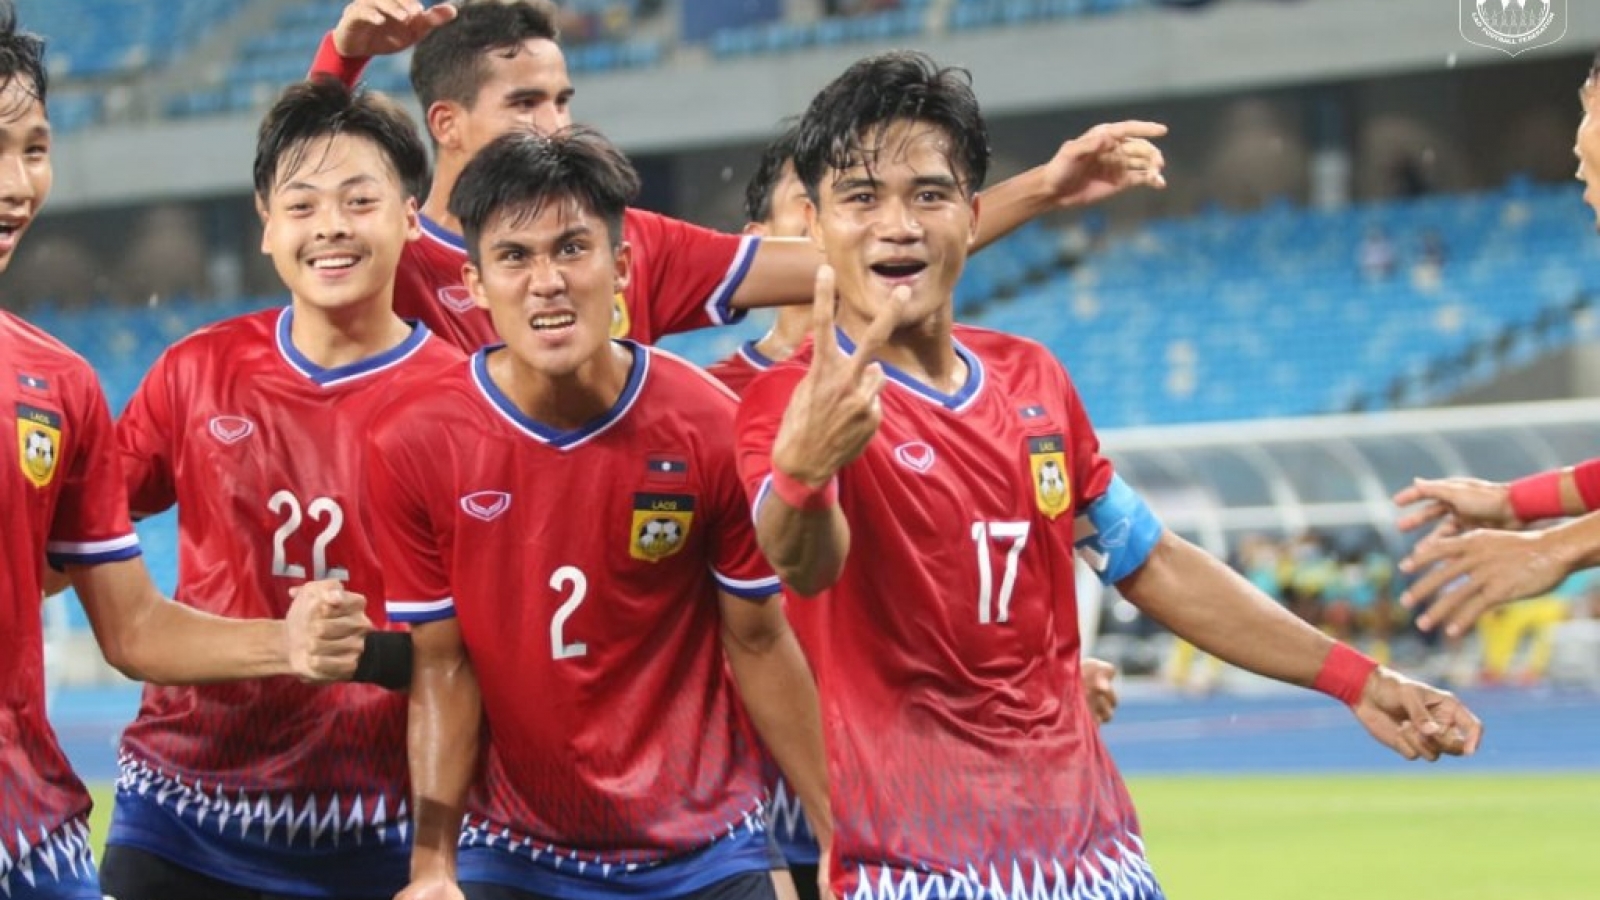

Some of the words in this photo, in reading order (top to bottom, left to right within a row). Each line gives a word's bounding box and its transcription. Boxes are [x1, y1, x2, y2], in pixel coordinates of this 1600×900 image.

[30, 411, 51, 425] LAOS
[267, 489, 350, 582] 22
[652, 501, 678, 510] LAOS
[549, 565, 588, 660] 2
[971, 521, 1031, 624] 17
